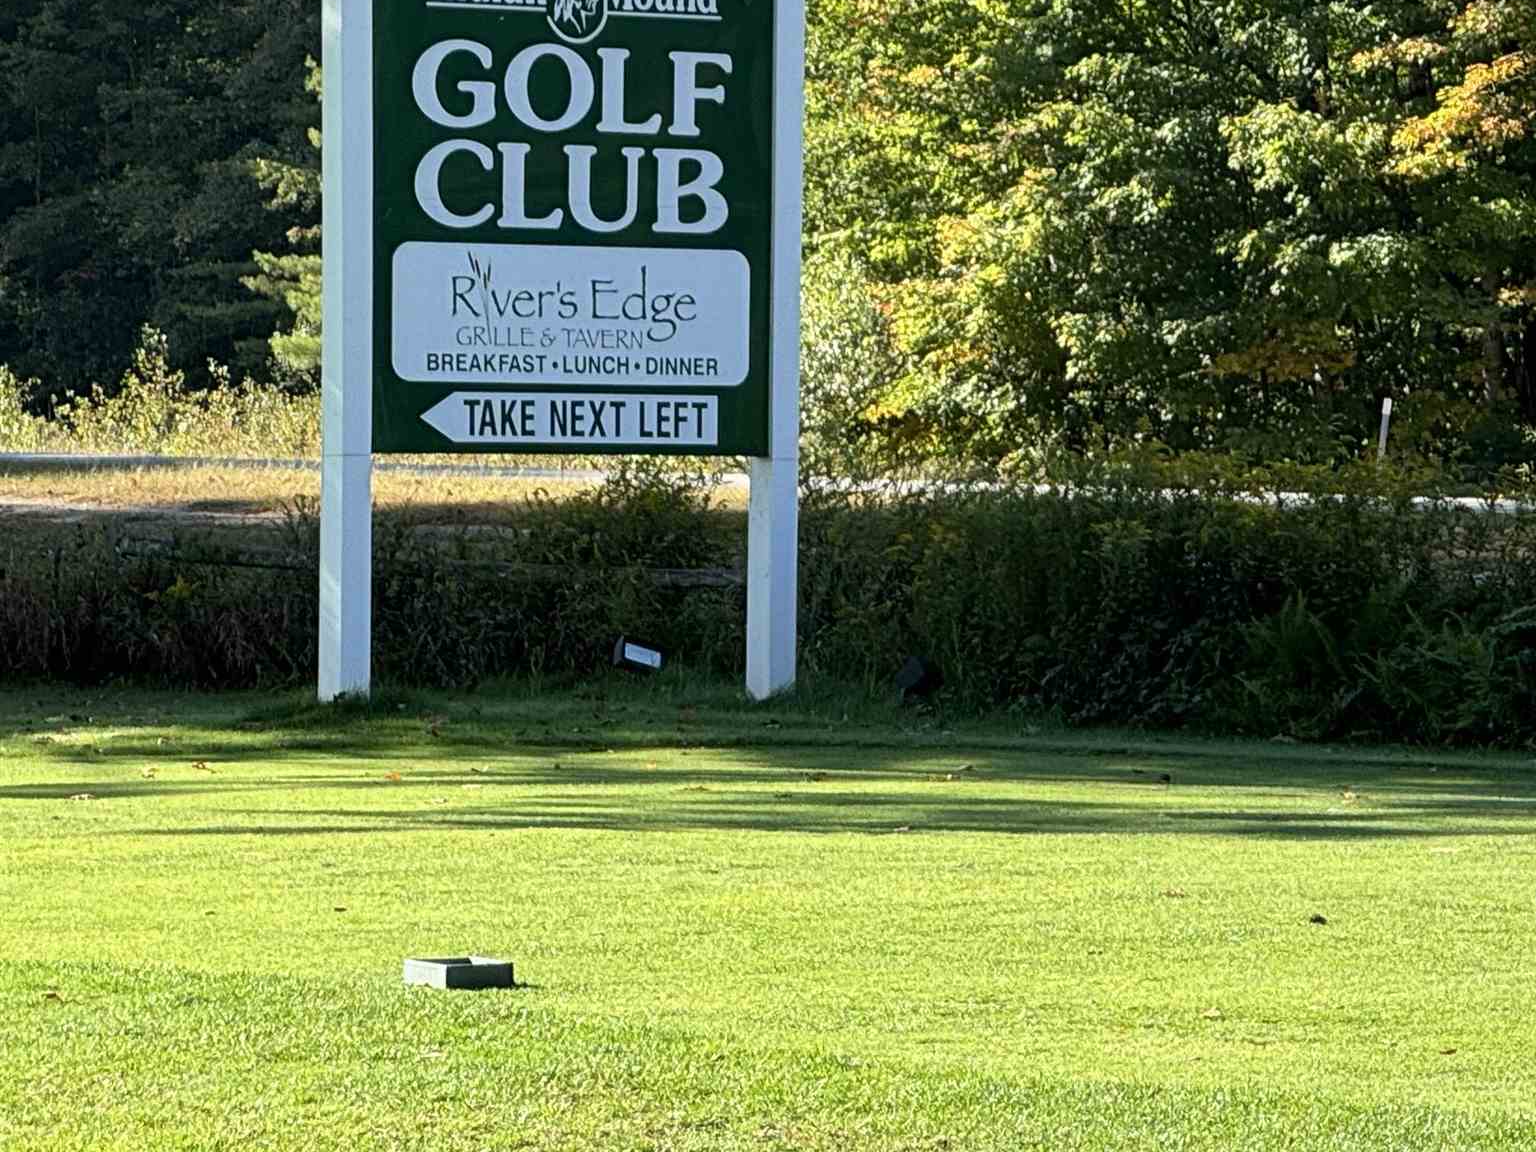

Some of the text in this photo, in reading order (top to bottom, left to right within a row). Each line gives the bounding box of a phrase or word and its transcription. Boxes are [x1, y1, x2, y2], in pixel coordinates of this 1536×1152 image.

[411, 38, 733, 136] GOLF
[413, 138, 729, 234] CLUB
[451, 251, 698, 342] River's Edge
[426, 354, 719, 377] BREAKFAST LUNCH DINNER
[456, 326, 644, 349] GRILLE & TAVERN
[463, 399, 708, 439] TAKE NEXT LEFT
